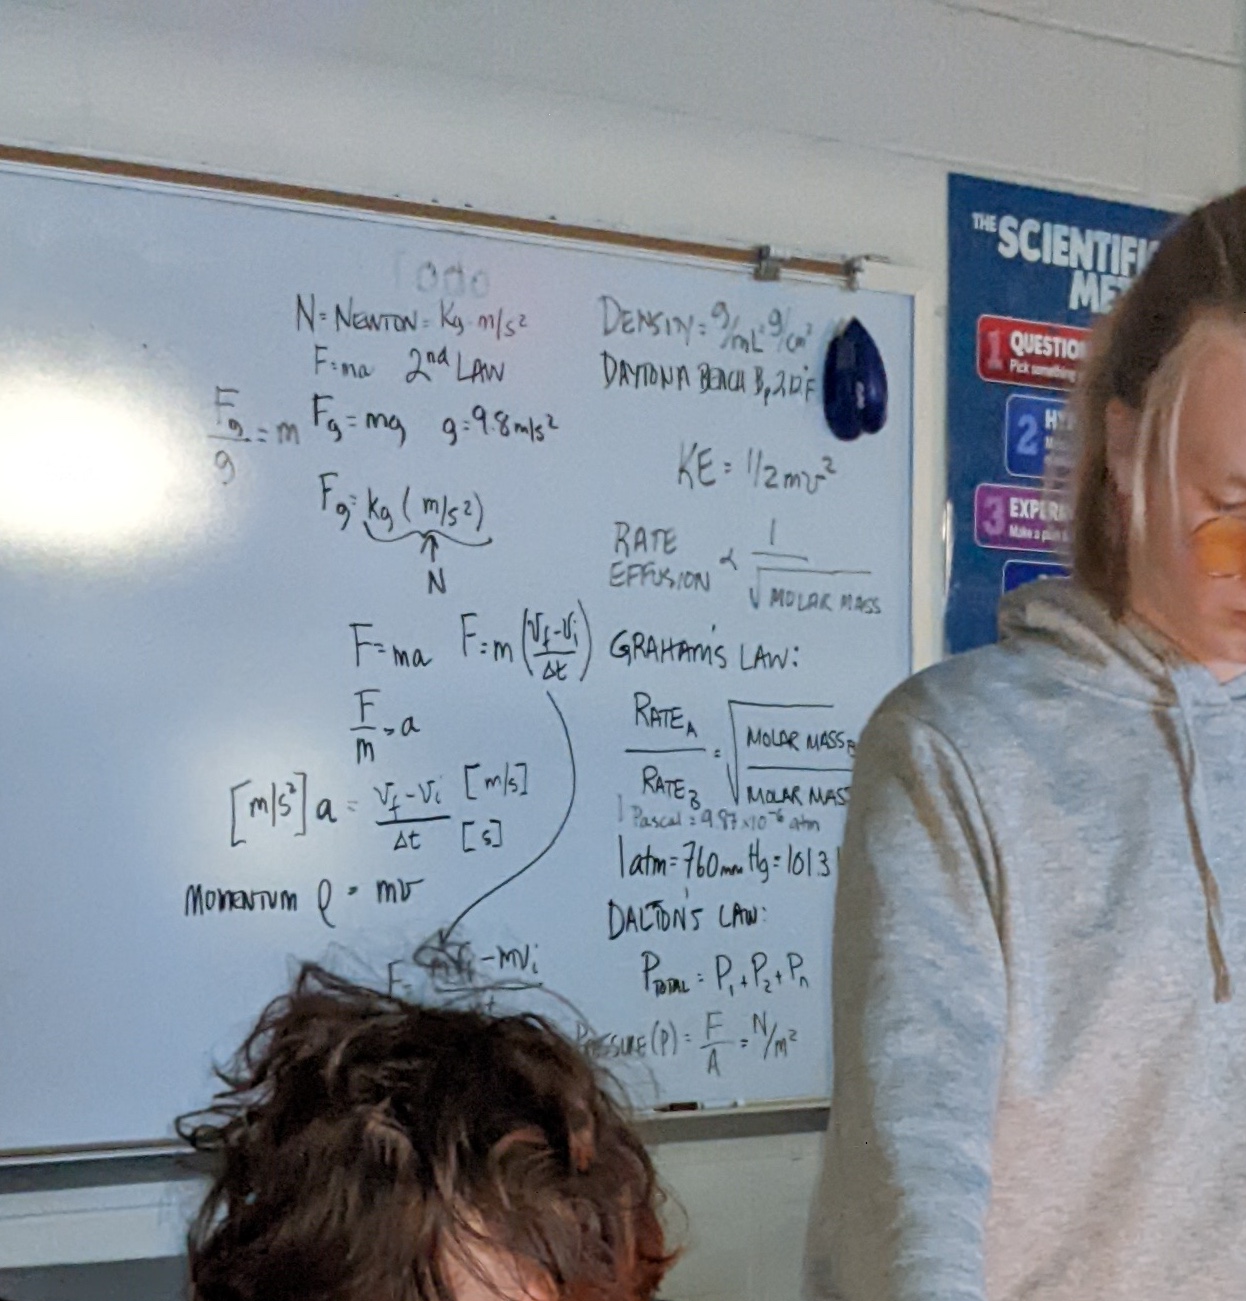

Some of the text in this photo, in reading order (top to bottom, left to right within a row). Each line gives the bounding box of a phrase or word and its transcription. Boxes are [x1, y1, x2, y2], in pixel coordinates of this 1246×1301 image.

[971, 212, 1161, 277] THE SCIENTIFI
[455, 351, 505, 383] LAW
[600, 349, 690, 391] DAYTONA
[698, 361, 746, 394] BEACH
[1016, 413, 1039, 456] 2
[982, 496, 1006, 536] 3
[614, 521, 678, 558] RATE
[427, 567, 447, 595] N
[609, 561, 711, 593] EFFUSION
[770, 587, 882, 615] MOLAR MASS
[747, 725, 801, 752] MOLAR
[746, 785, 802, 806] MOLAR
[185, 883, 299, 916] MOMENTUM
